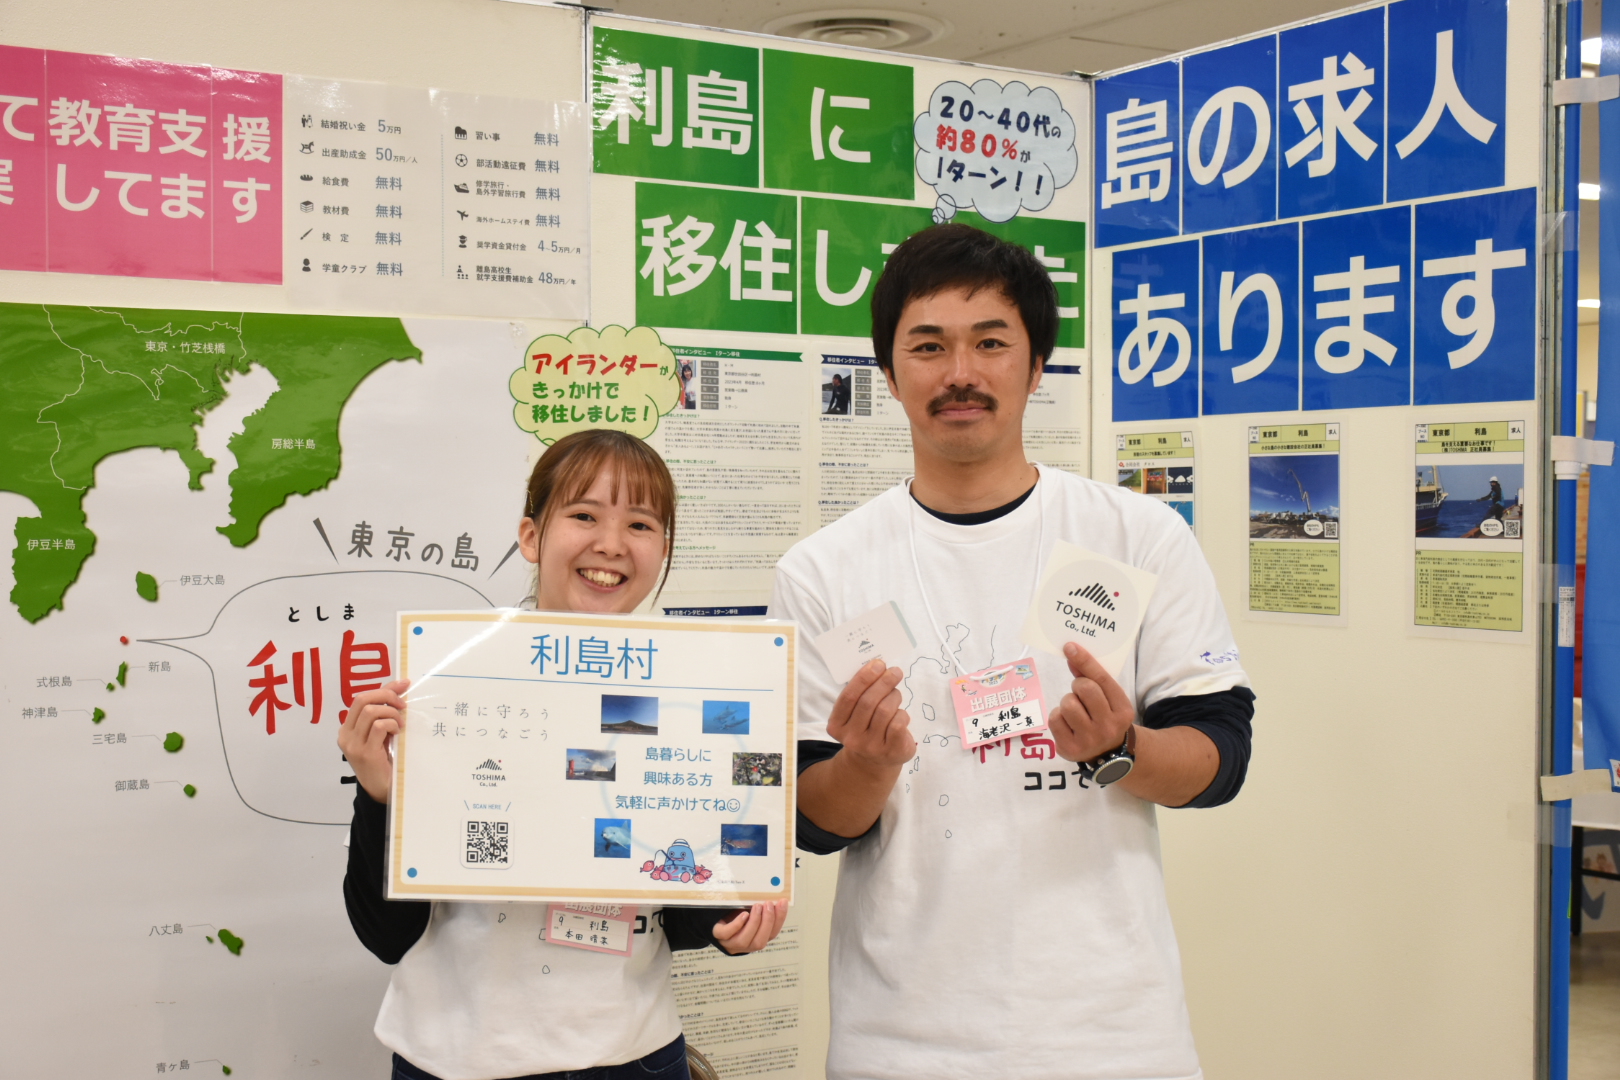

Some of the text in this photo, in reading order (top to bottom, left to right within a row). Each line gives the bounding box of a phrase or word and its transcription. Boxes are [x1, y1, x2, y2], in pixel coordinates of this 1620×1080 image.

[592, 62, 871, 163] 利島に
[1101, 29, 1497, 209] 島の求人
[321, 119, 401, 134] 結婚祝い金 5万円
[475, 131, 559, 147] 習い事 無料
[935, 124, 1031, 163] 約80%が
[321, 149, 366, 160] 出産助成金
[476, 159, 560, 174] 部活動遠征費 無料
[322, 176, 402, 191] 給食費 無料
[476, 187, 561, 201] 島外学習旅行費 無料
[322, 204, 402, 219] 教材費 無料
[476, 214, 561, 228] 海外ホームステイ費 無料
[375, 231, 402, 246] 無料
[476, 241, 527, 251] 奨学資金貸付金
[322, 262, 403, 277] 学童クラブ 無料
[476, 265, 512, 274] 離島高校生
[476, 273, 534, 284] 就学支援費補助金
[1117, 238, 1526, 388] あります
[145, 341, 226, 354] 東京・竹芝桟橋
[532, 353, 669, 376] アイランダーが
[532, 381, 619, 399] きっかけで
[532, 404, 649, 424] 移住しました！
[1298, 429, 1308, 437] 利島
[1432, 429, 1450, 437] 東京都
[1474, 427, 1487, 436] 利島
[271, 438, 316, 450] 房総半島
[27, 539, 76, 551] 伊豆半島
[347, 520, 479, 571] 東京の島
[180, 575, 225, 586] 伊豆大島
[1056, 600, 1116, 632] TOSHIMA
[1064, 620, 1096, 638] Co., Ltd.
[530, 633, 658, 680] 利島村
[148, 661, 171, 672] 新島
[36, 676, 72, 688] 式根島
[970, 686, 1027, 712] 出展団体
[21, 707, 58, 719] 神津島
[433, 701, 550, 720] 一緒に守ろう
[971, 706, 1021, 727] 9 利島
[92, 733, 127, 745] 三宅島
[432, 722, 549, 741] 共につなごう
[645, 747, 712, 762] 島暮らしに
[471, 773, 506, 781] TOSHIMA
[643, 771, 713, 787] 興味ある方
[115, 779, 150, 792] 御蔵島
[615, 795, 727, 812] 気軽に声かけてね
[149, 923, 183, 936] 八丈島
[590, 920, 609, 932] 利島
[156, 1059, 190, 1074] 青ヶ島
